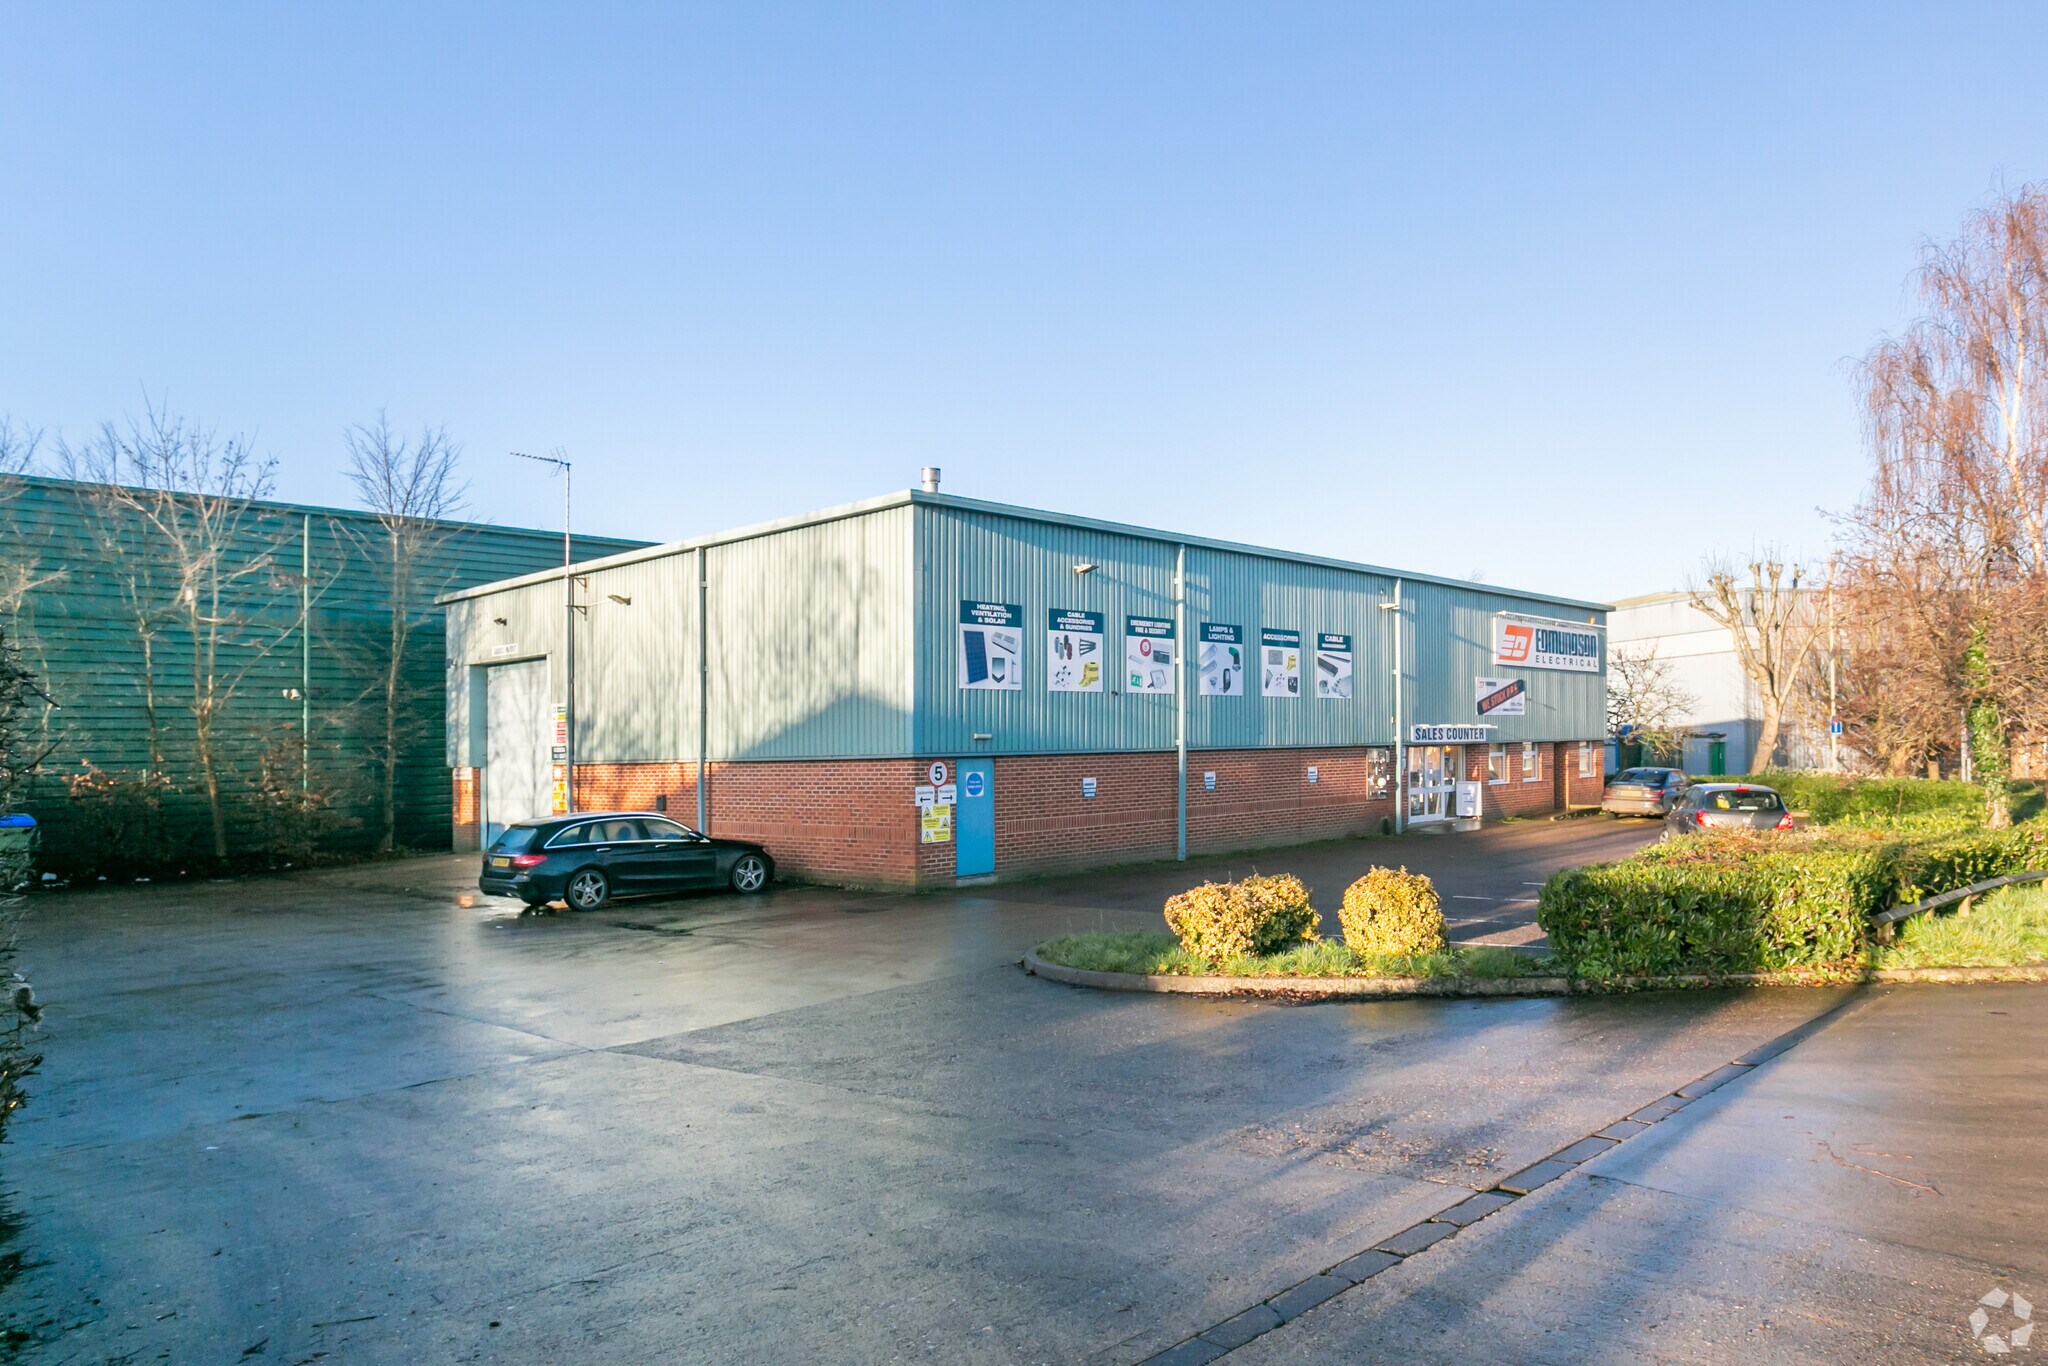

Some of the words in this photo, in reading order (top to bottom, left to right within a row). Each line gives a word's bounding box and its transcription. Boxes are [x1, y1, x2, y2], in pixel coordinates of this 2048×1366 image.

[977, 604, 1006, 612] HEATING,
[971, 610, 1012, 618] VENTILATION
[984, 617, 1006, 625] SOLAR
[1057, 617, 1095, 626] ACCESSORIES
[1209, 625, 1228, 633] LAMPS
[1208, 632, 1235, 641] LIGHTING
[1263, 633, 1299, 642] ACCESSORIES
[1324, 635, 1344, 643] CABLE
[1535, 628, 1597, 658] EDMUNDSON
[1535, 654, 1598, 668] ELECTRICAL
[1415, 728, 1444, 740] SALES
[1446, 727, 1485, 740] COUNTER
[934, 765, 943, 781] 5
